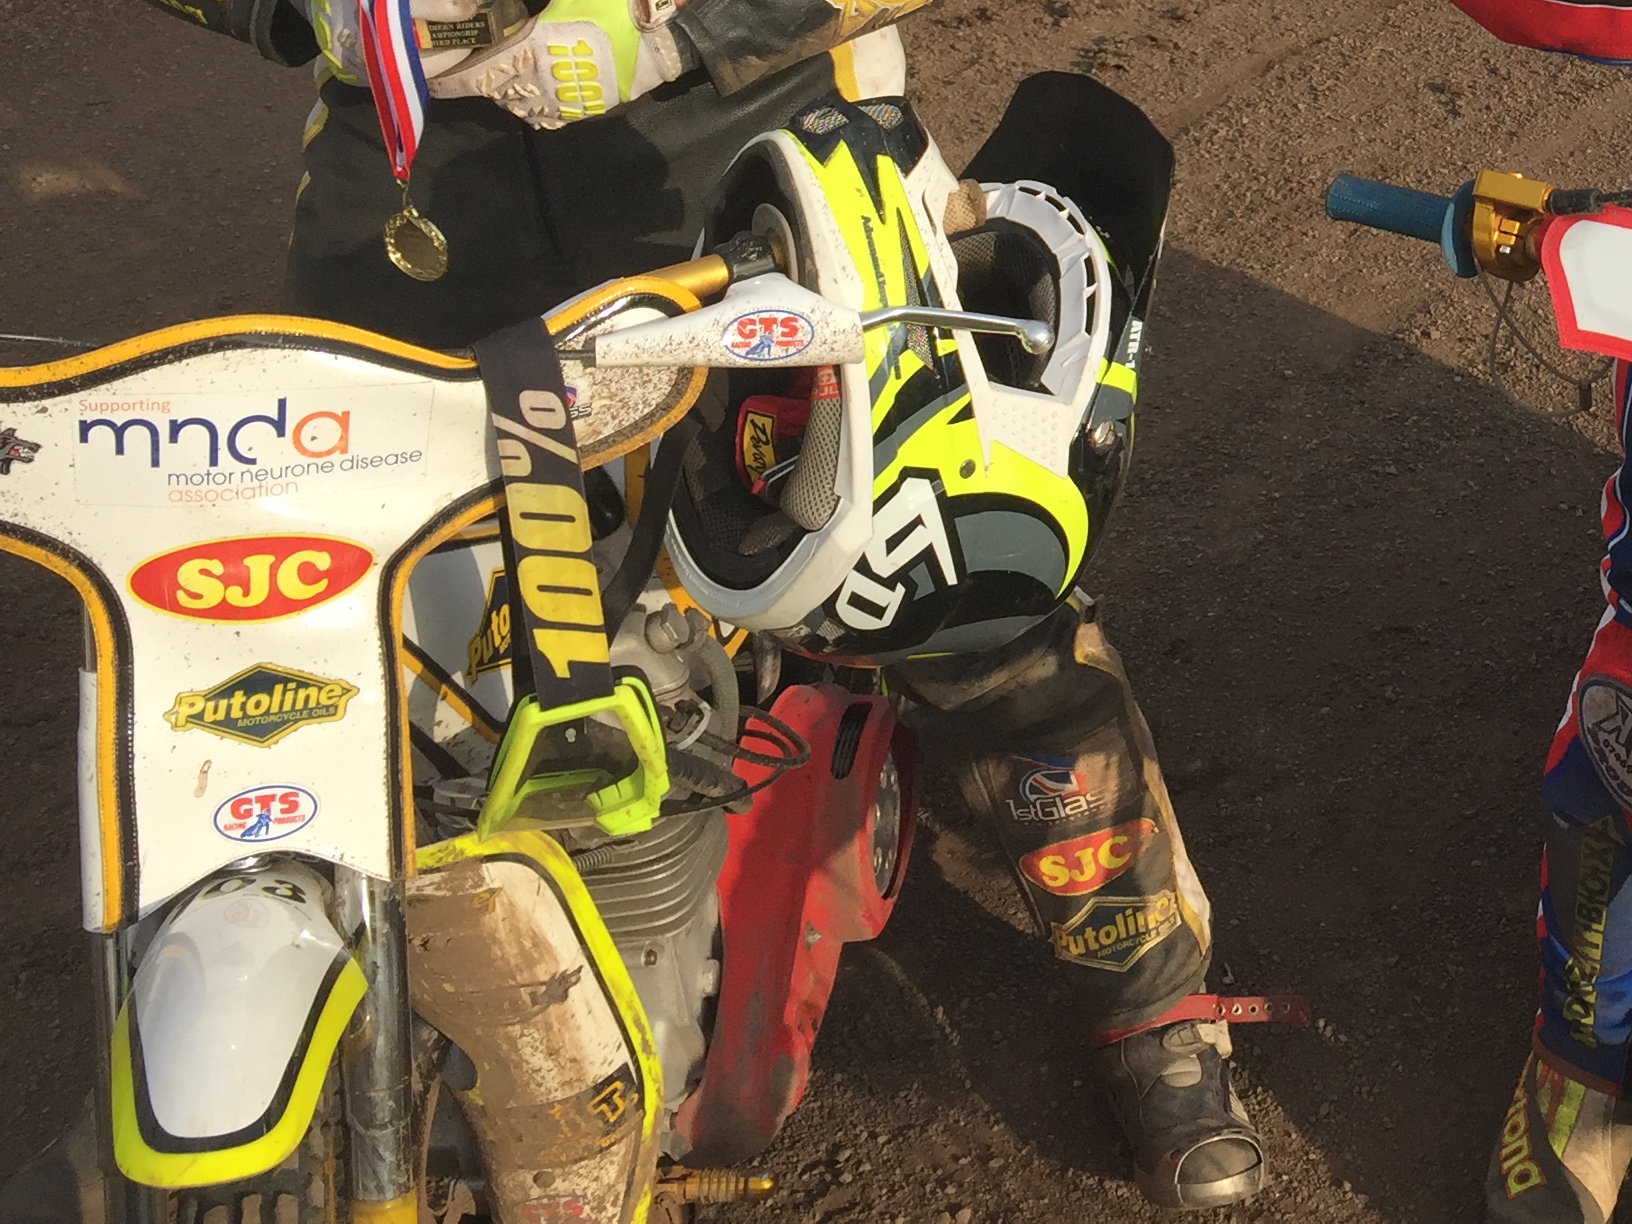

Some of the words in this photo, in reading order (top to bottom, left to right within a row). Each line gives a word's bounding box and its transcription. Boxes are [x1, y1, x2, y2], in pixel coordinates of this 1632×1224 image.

[737, 317, 800, 340] GTS
[79, 399, 171, 414] Supporting
[78, 397, 351, 468] mnda
[167, 467, 233, 487] motor
[240, 459, 335, 484] neurone
[339, 448, 423, 472] disease
[168, 478, 299, 503] association
[175, 549, 332, 610] SJC
[467, 603, 511, 672] Puto
[174, 682, 343, 727] Putoline
[237, 708, 309, 728] MOTORCYCLE
[311, 706, 336, 718] OILS
[230, 791, 300, 821] GTS
[1039, 835, 1132, 888] SJC
[1056, 896, 1171, 956] Putoline
